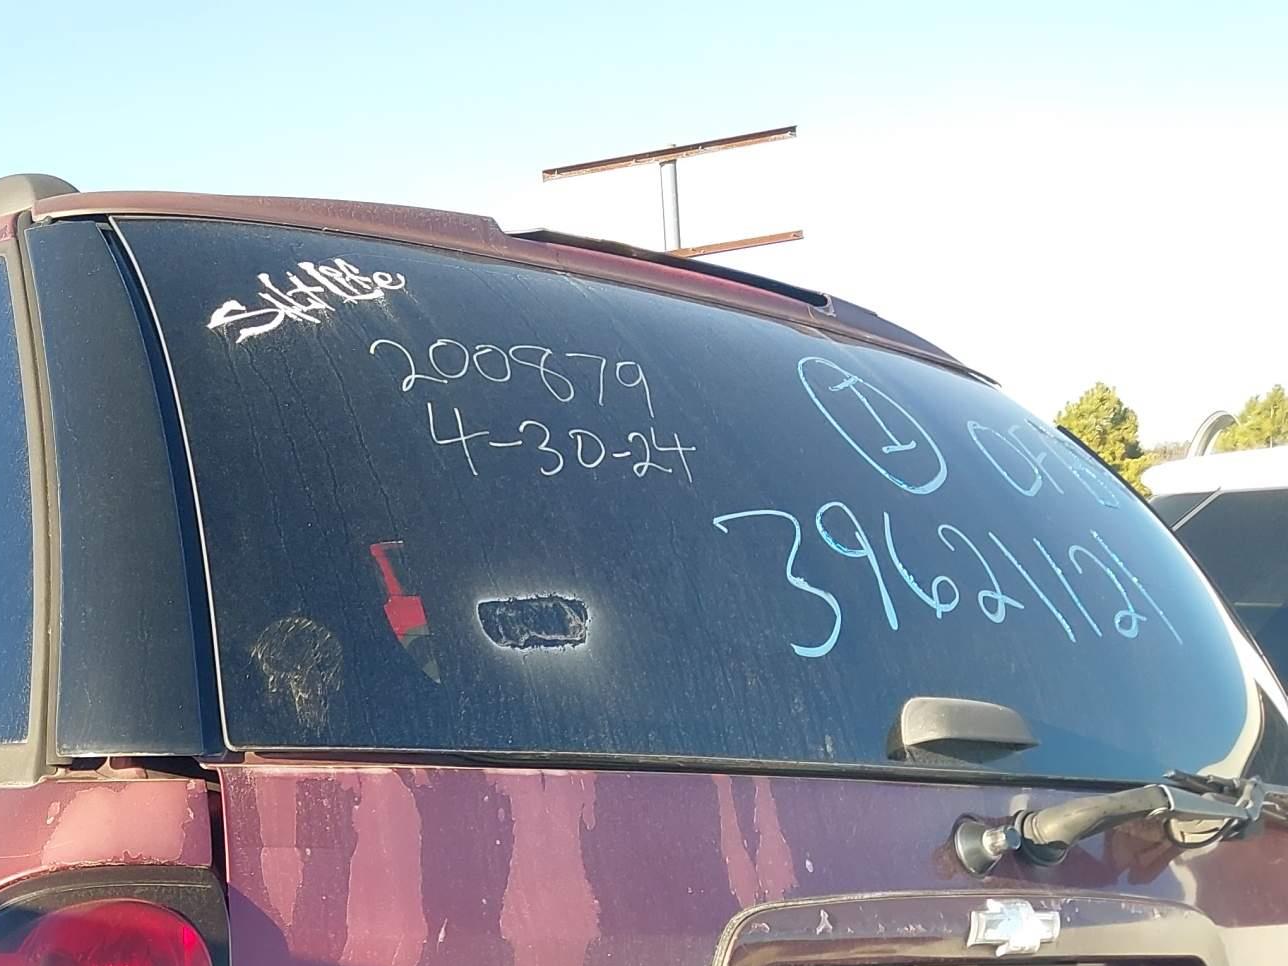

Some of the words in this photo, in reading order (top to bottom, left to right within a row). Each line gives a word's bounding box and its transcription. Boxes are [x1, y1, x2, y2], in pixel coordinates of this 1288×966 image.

[370, 339, 654, 418] 200879
[427, 402, 696, 482] 4-30-24
[713, 501, 1183, 657] 39621121
